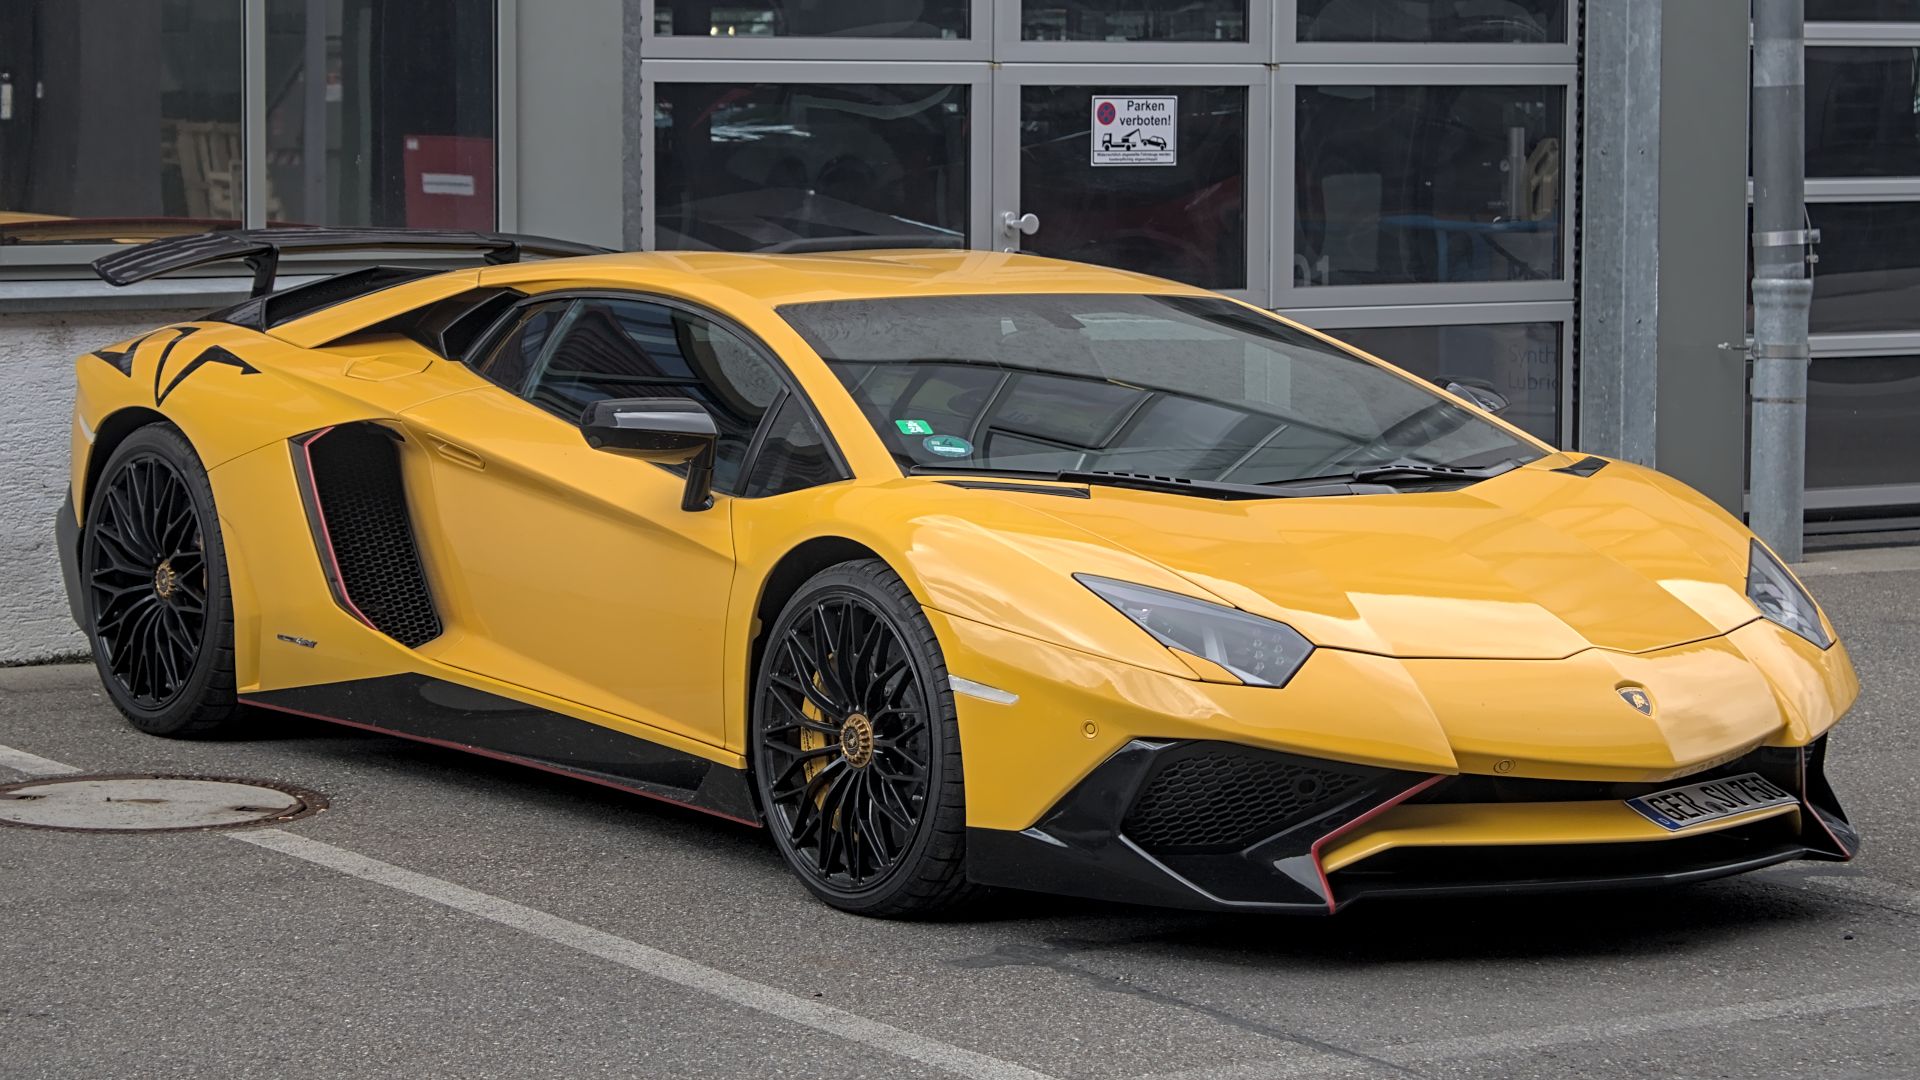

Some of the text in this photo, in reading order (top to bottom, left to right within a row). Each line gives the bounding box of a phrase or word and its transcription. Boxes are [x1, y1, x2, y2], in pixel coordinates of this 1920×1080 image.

[1127, 100, 1165, 111] Parken
[1120, 114, 1171, 126] verboten!
[1647, 791, 1714, 820] GER
